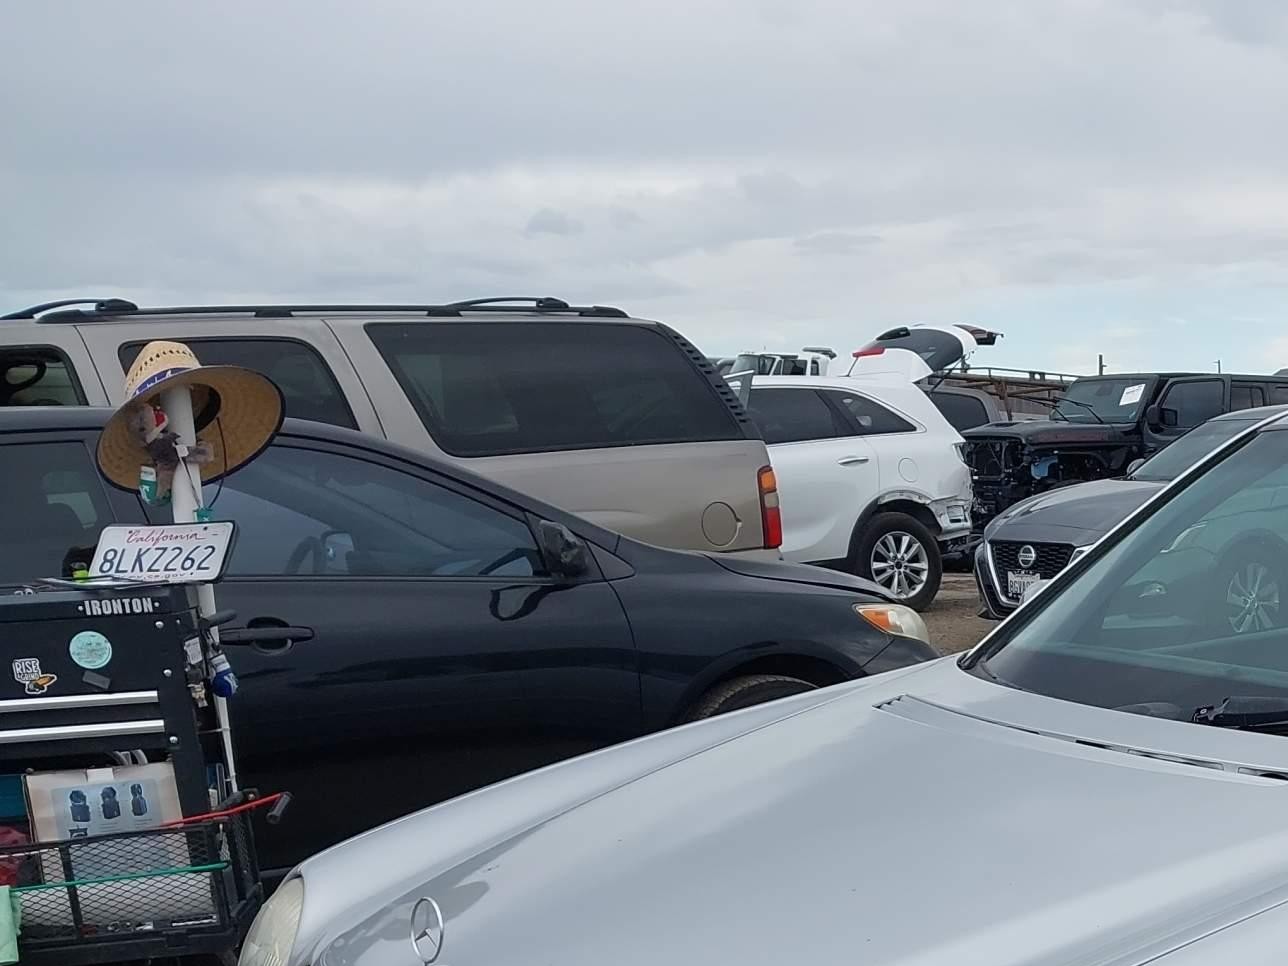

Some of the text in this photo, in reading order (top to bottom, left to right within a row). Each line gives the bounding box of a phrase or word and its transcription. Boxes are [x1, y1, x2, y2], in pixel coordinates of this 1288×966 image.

[127, 529, 208, 547] California
[98, 545, 217, 574] 8LKZ262
[83, 597, 154, 616] IRONTON
[15, 660, 39, 674] RISE
